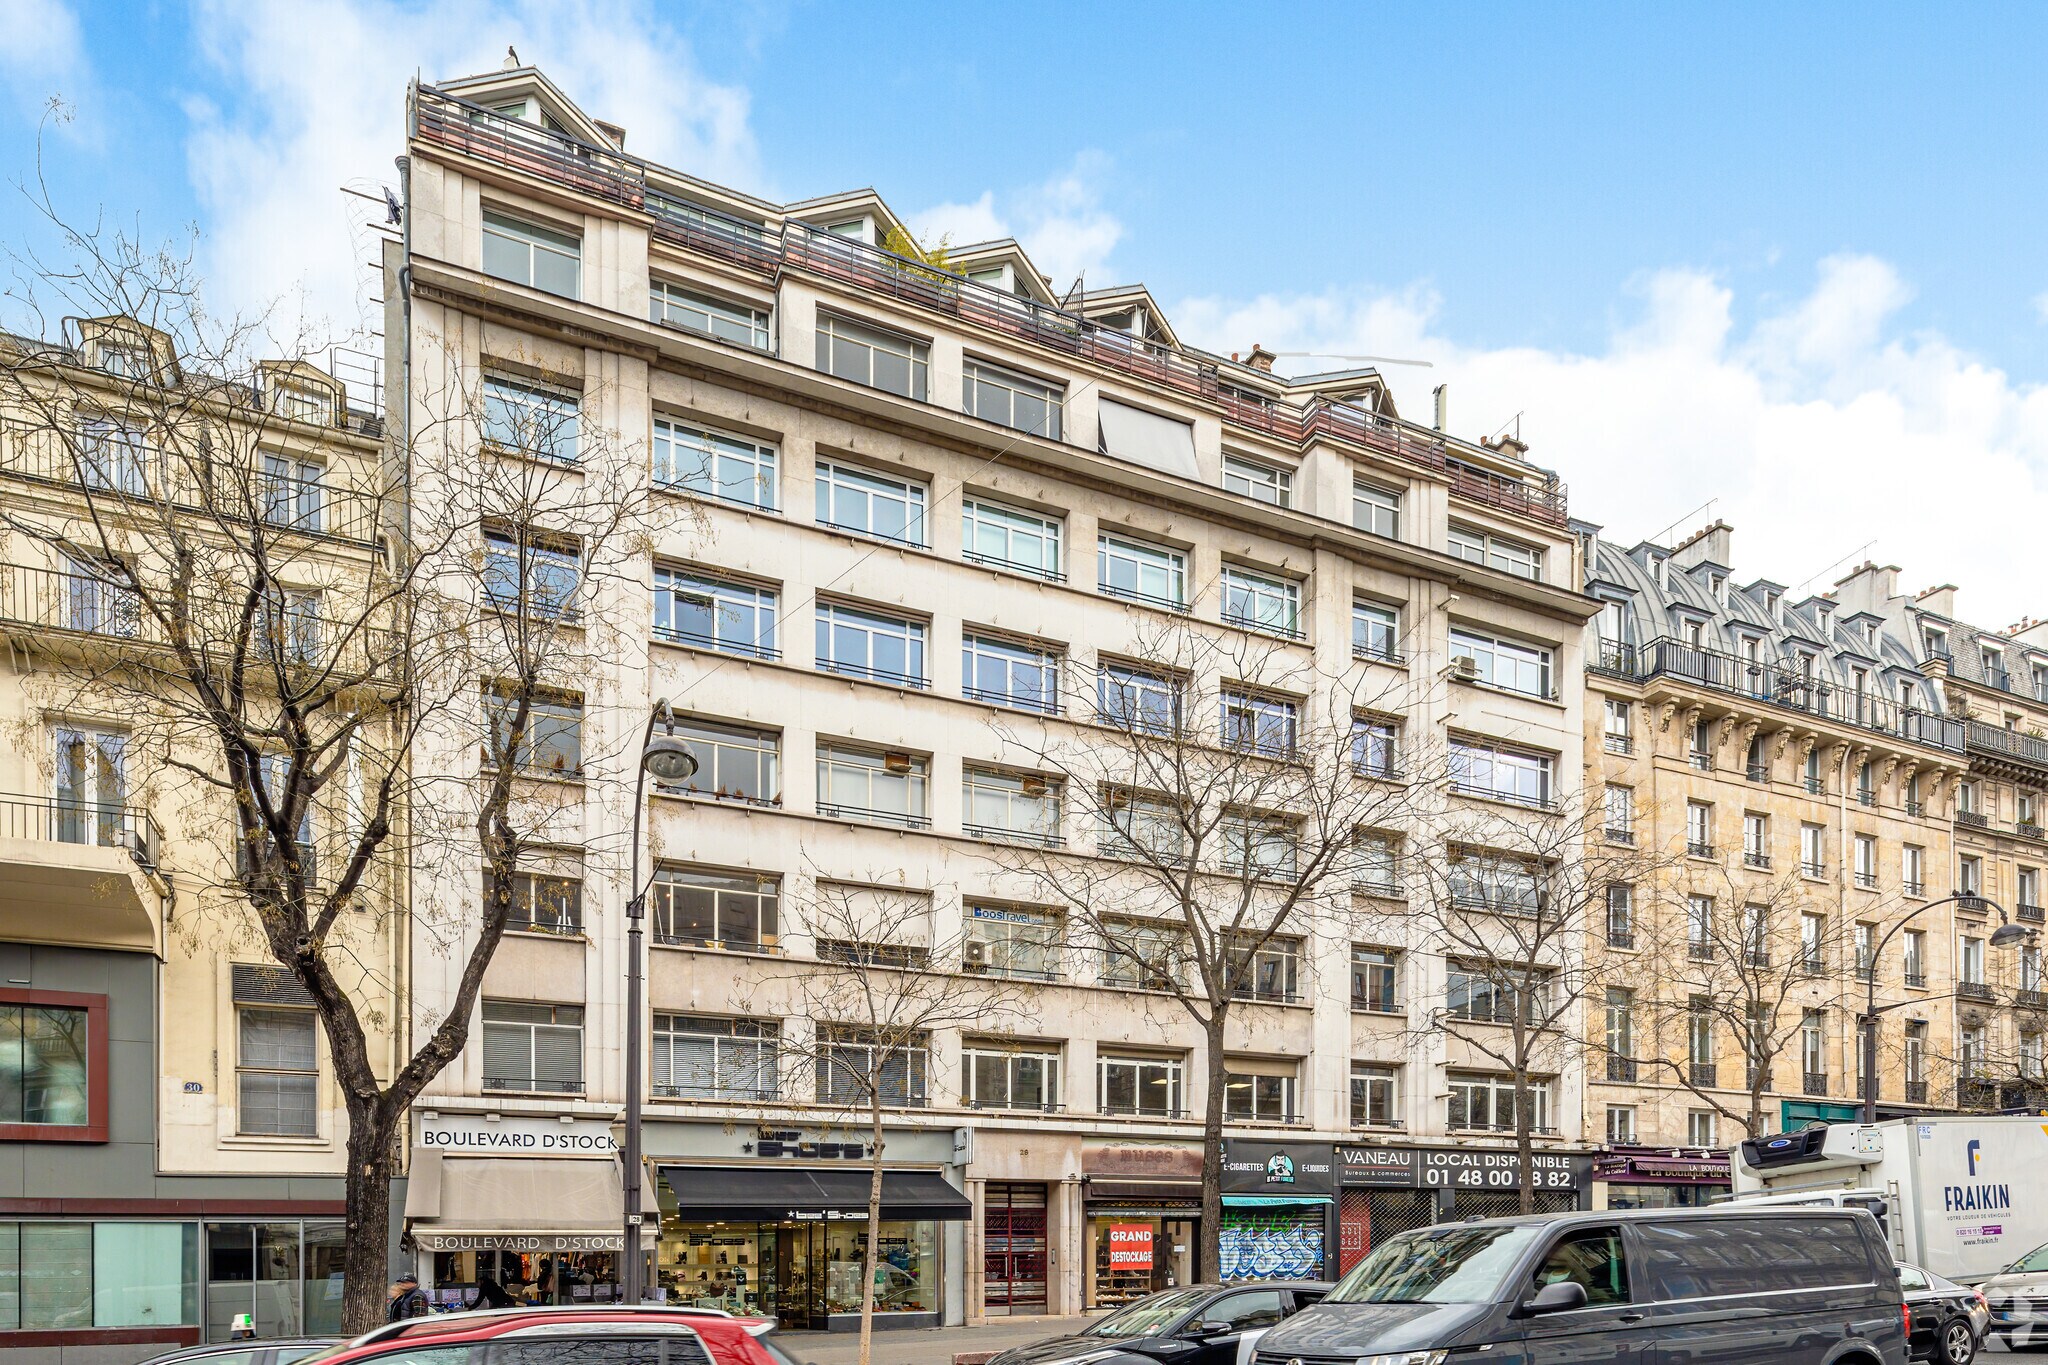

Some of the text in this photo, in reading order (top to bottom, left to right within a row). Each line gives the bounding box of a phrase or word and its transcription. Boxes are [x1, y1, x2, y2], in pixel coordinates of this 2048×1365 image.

[186, 1083, 200, 1092] 30
[1918, 1126, 1931, 1134] FRC
[424, 1131, 619, 1149] BOULEVARD D'STOCK
[1343, 1151, 1411, 1165] VANEAU
[1426, 1153, 1570, 1169] LOCAL DISPNIBLE
[1223, 1162, 1264, 1172] E-CIGARETTES
[1301, 1164, 1330, 1173] E-LIQUIDES
[1701, 1165, 1730, 1173] BOUTIQUE
[1426, 1169, 1571, 1187] 01 48 00 8 82
[1944, 1184, 2010, 1211] FRAIKIN
[1110, 1231, 1152, 1242] GRAND
[1341, 1237, 1358, 1246] DES
[1963, 1236, 1999, 1246] www.fraikin.fr
[433, 1237, 624, 1249] BOULEVARD D'STOCK
[1111, 1251, 1152, 1263] DESTOCKAGE
